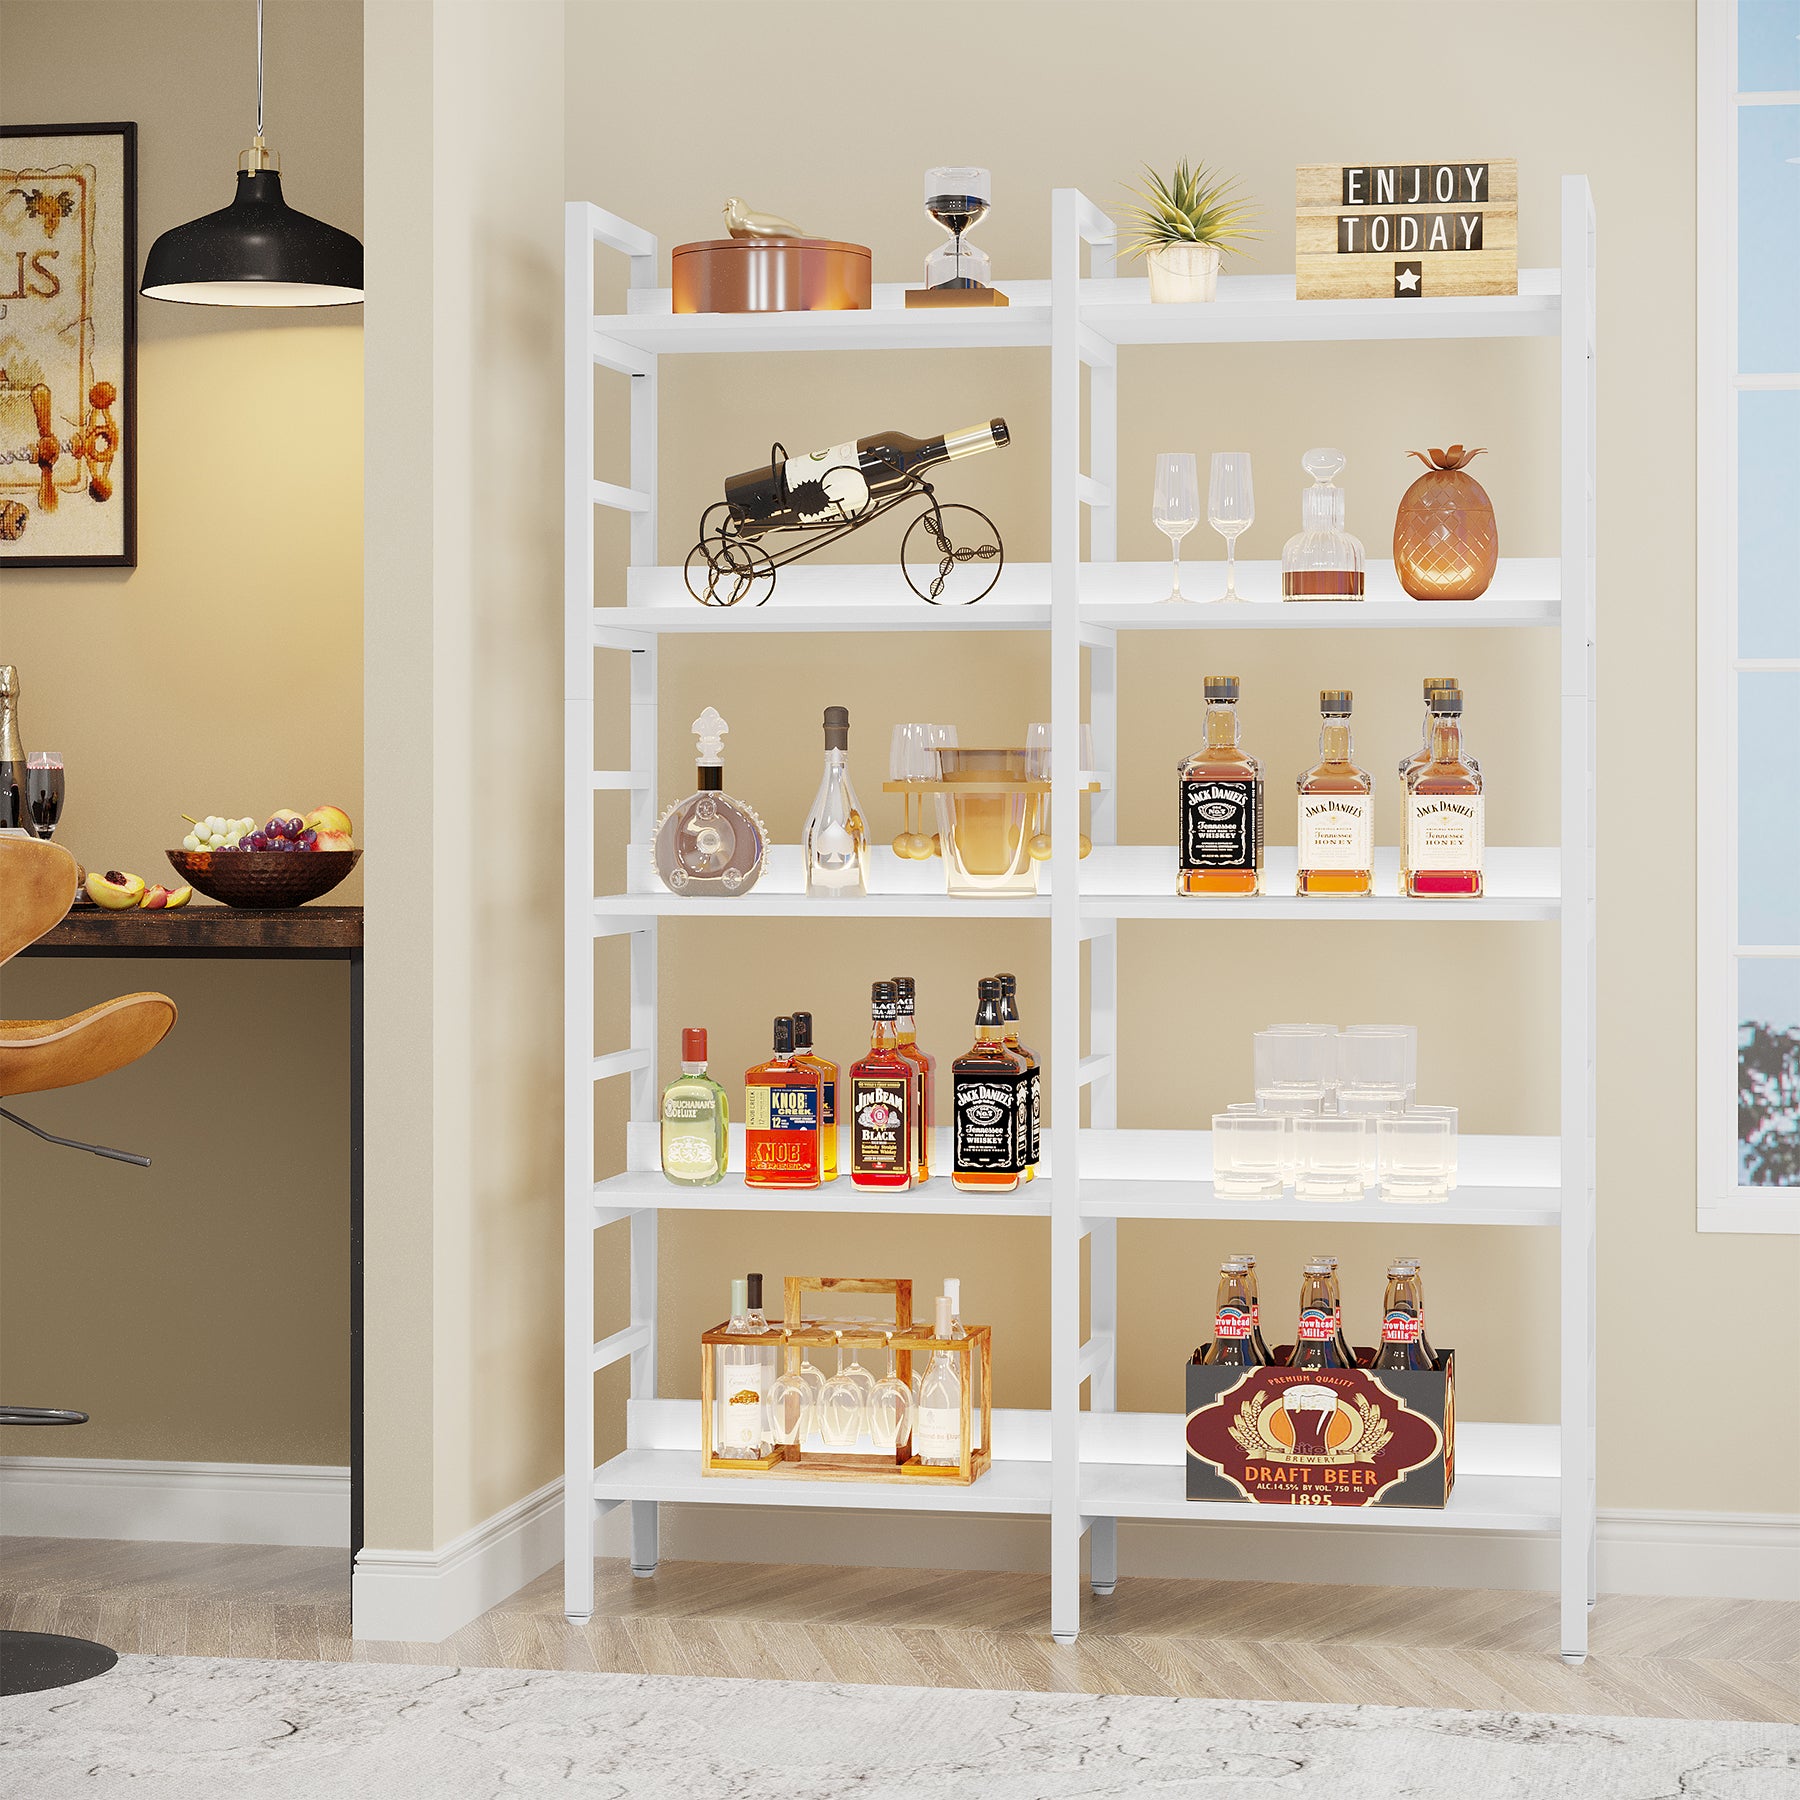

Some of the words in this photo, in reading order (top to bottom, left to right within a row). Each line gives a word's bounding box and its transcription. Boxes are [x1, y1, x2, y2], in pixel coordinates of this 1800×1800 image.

[1348, 166, 1484, 204] ENJOY
[1341, 215, 1479, 252] TODAY
[1187, 789, 1212, 806] JACK
[1211, 786, 1248, 806] DANIEL'S
[1305, 804, 1328, 818] JACK
[1328, 800, 1364, 818] DANIEL'S
[1416, 804, 1439, 818] JACK
[1439, 800, 1475, 818] DANIEL'S
[772, 1092, 805, 1109] KNOB
[855, 1090, 875, 1113] JIM
[875, 1088, 903, 1113] BEAM
[957, 1089, 979, 1106] JACK
[979, 1086, 1014, 1107] DANIEL'S
[672, 1109, 697, 1118] DELUXE
[771, 1117, 781, 1128] 12
[861, 1129, 896, 1141] BLACK
[1218, 1326, 1241, 1336] Mills
[1302, 1328, 1325, 1338] Mills
[1386, 1330, 1409, 1340] Mills
[1267, 1375, 1310, 1386] PREMIUM
[1315, 1376, 1354, 1388] QUALITY
[1285, 1455, 1336, 1464] BREWERY
[1245, 1466, 1312, 1483] DRAFT
[1324, 1469, 1378, 1485] BEER
[1314, 1484, 1332, 1492] VOL.
[1335, 1485, 1350, 1493] 750
[1290, 1493, 1333, 1506] 1895
